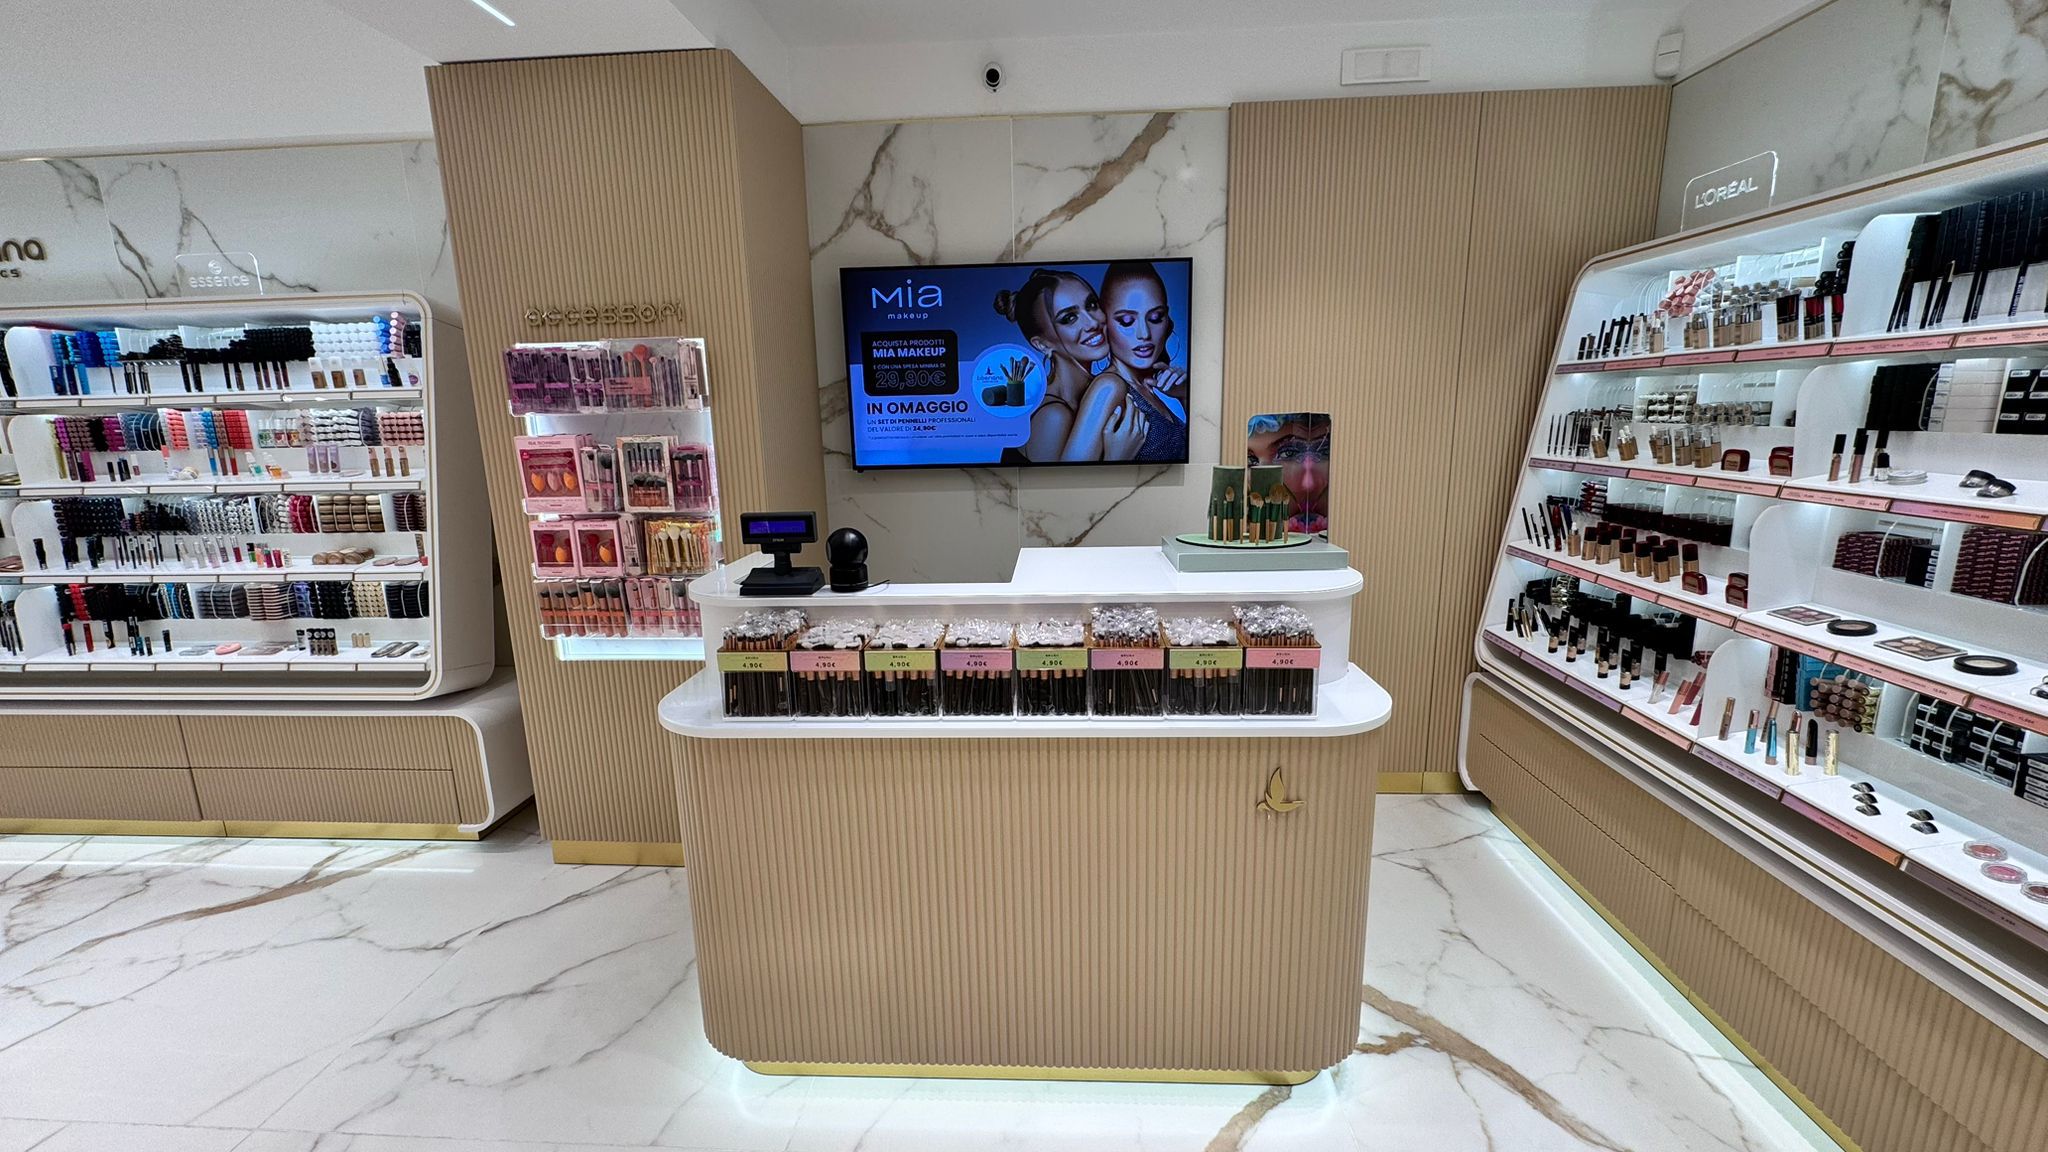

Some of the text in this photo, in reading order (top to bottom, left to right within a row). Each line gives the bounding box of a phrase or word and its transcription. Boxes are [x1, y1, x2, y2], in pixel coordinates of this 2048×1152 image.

[1695, 177, 1758, 209] L'ORÉAL
[0, 239, 46, 262] na
[189, 275, 249, 288] essence
[872, 279, 942, 309] Mia
[525, 302, 683, 327] accessori
[887, 312, 929, 320] makeup
[872, 340, 908, 348] ACQUISTA
[873, 347, 946, 358] MIA MAKEUP
[876, 370, 946, 390] 29,90€
[867, 400, 968, 415] IN OMAGGIO
